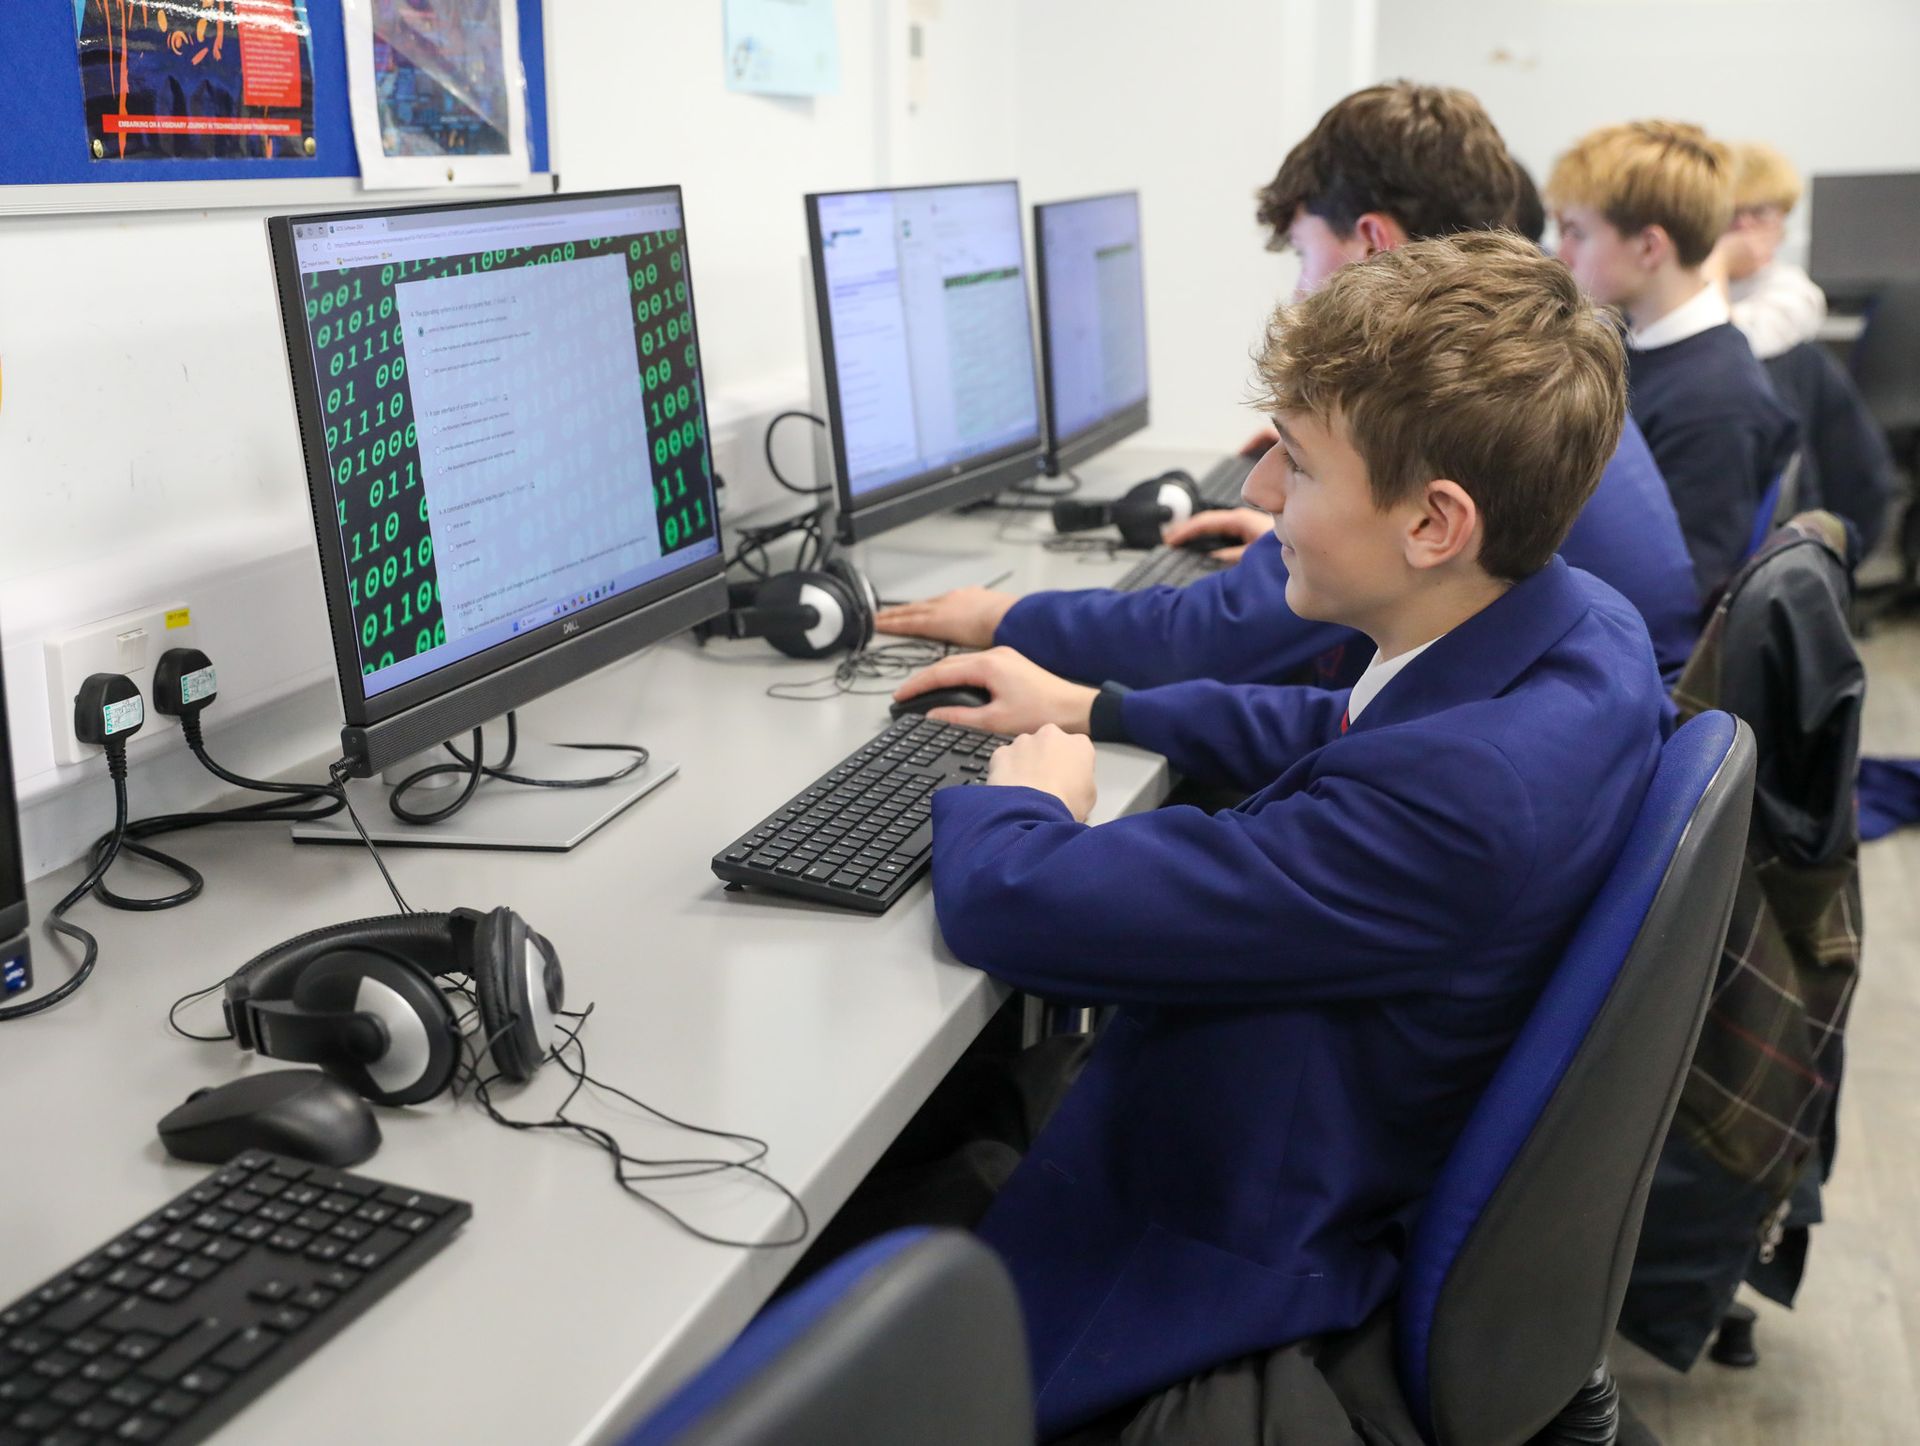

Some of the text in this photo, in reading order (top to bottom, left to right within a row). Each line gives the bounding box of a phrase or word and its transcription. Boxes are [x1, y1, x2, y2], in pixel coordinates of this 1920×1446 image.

[118, 120, 149, 129] EMBARKING
[149, 120, 157, 128] ON
[161, 121, 187, 129] VISIONARY
[187, 121, 208, 130] JOURNEY
[213, 122, 243, 130] TECHNOLOGY
[316, 296, 399, 348] 01010
[331, 325, 402, 376] 01110
[327, 381, 355, 414] 01
[376, 357, 405, 388] 00
[326, 392, 404, 450] 01110
[331, 422, 417, 486] 01000
[368, 463, 421, 508] 011
[351, 511, 401, 563] 110
[664, 498, 707, 549] 011
[350, 535, 433, 608] 10010
[563, 620, 580, 635] DELL
